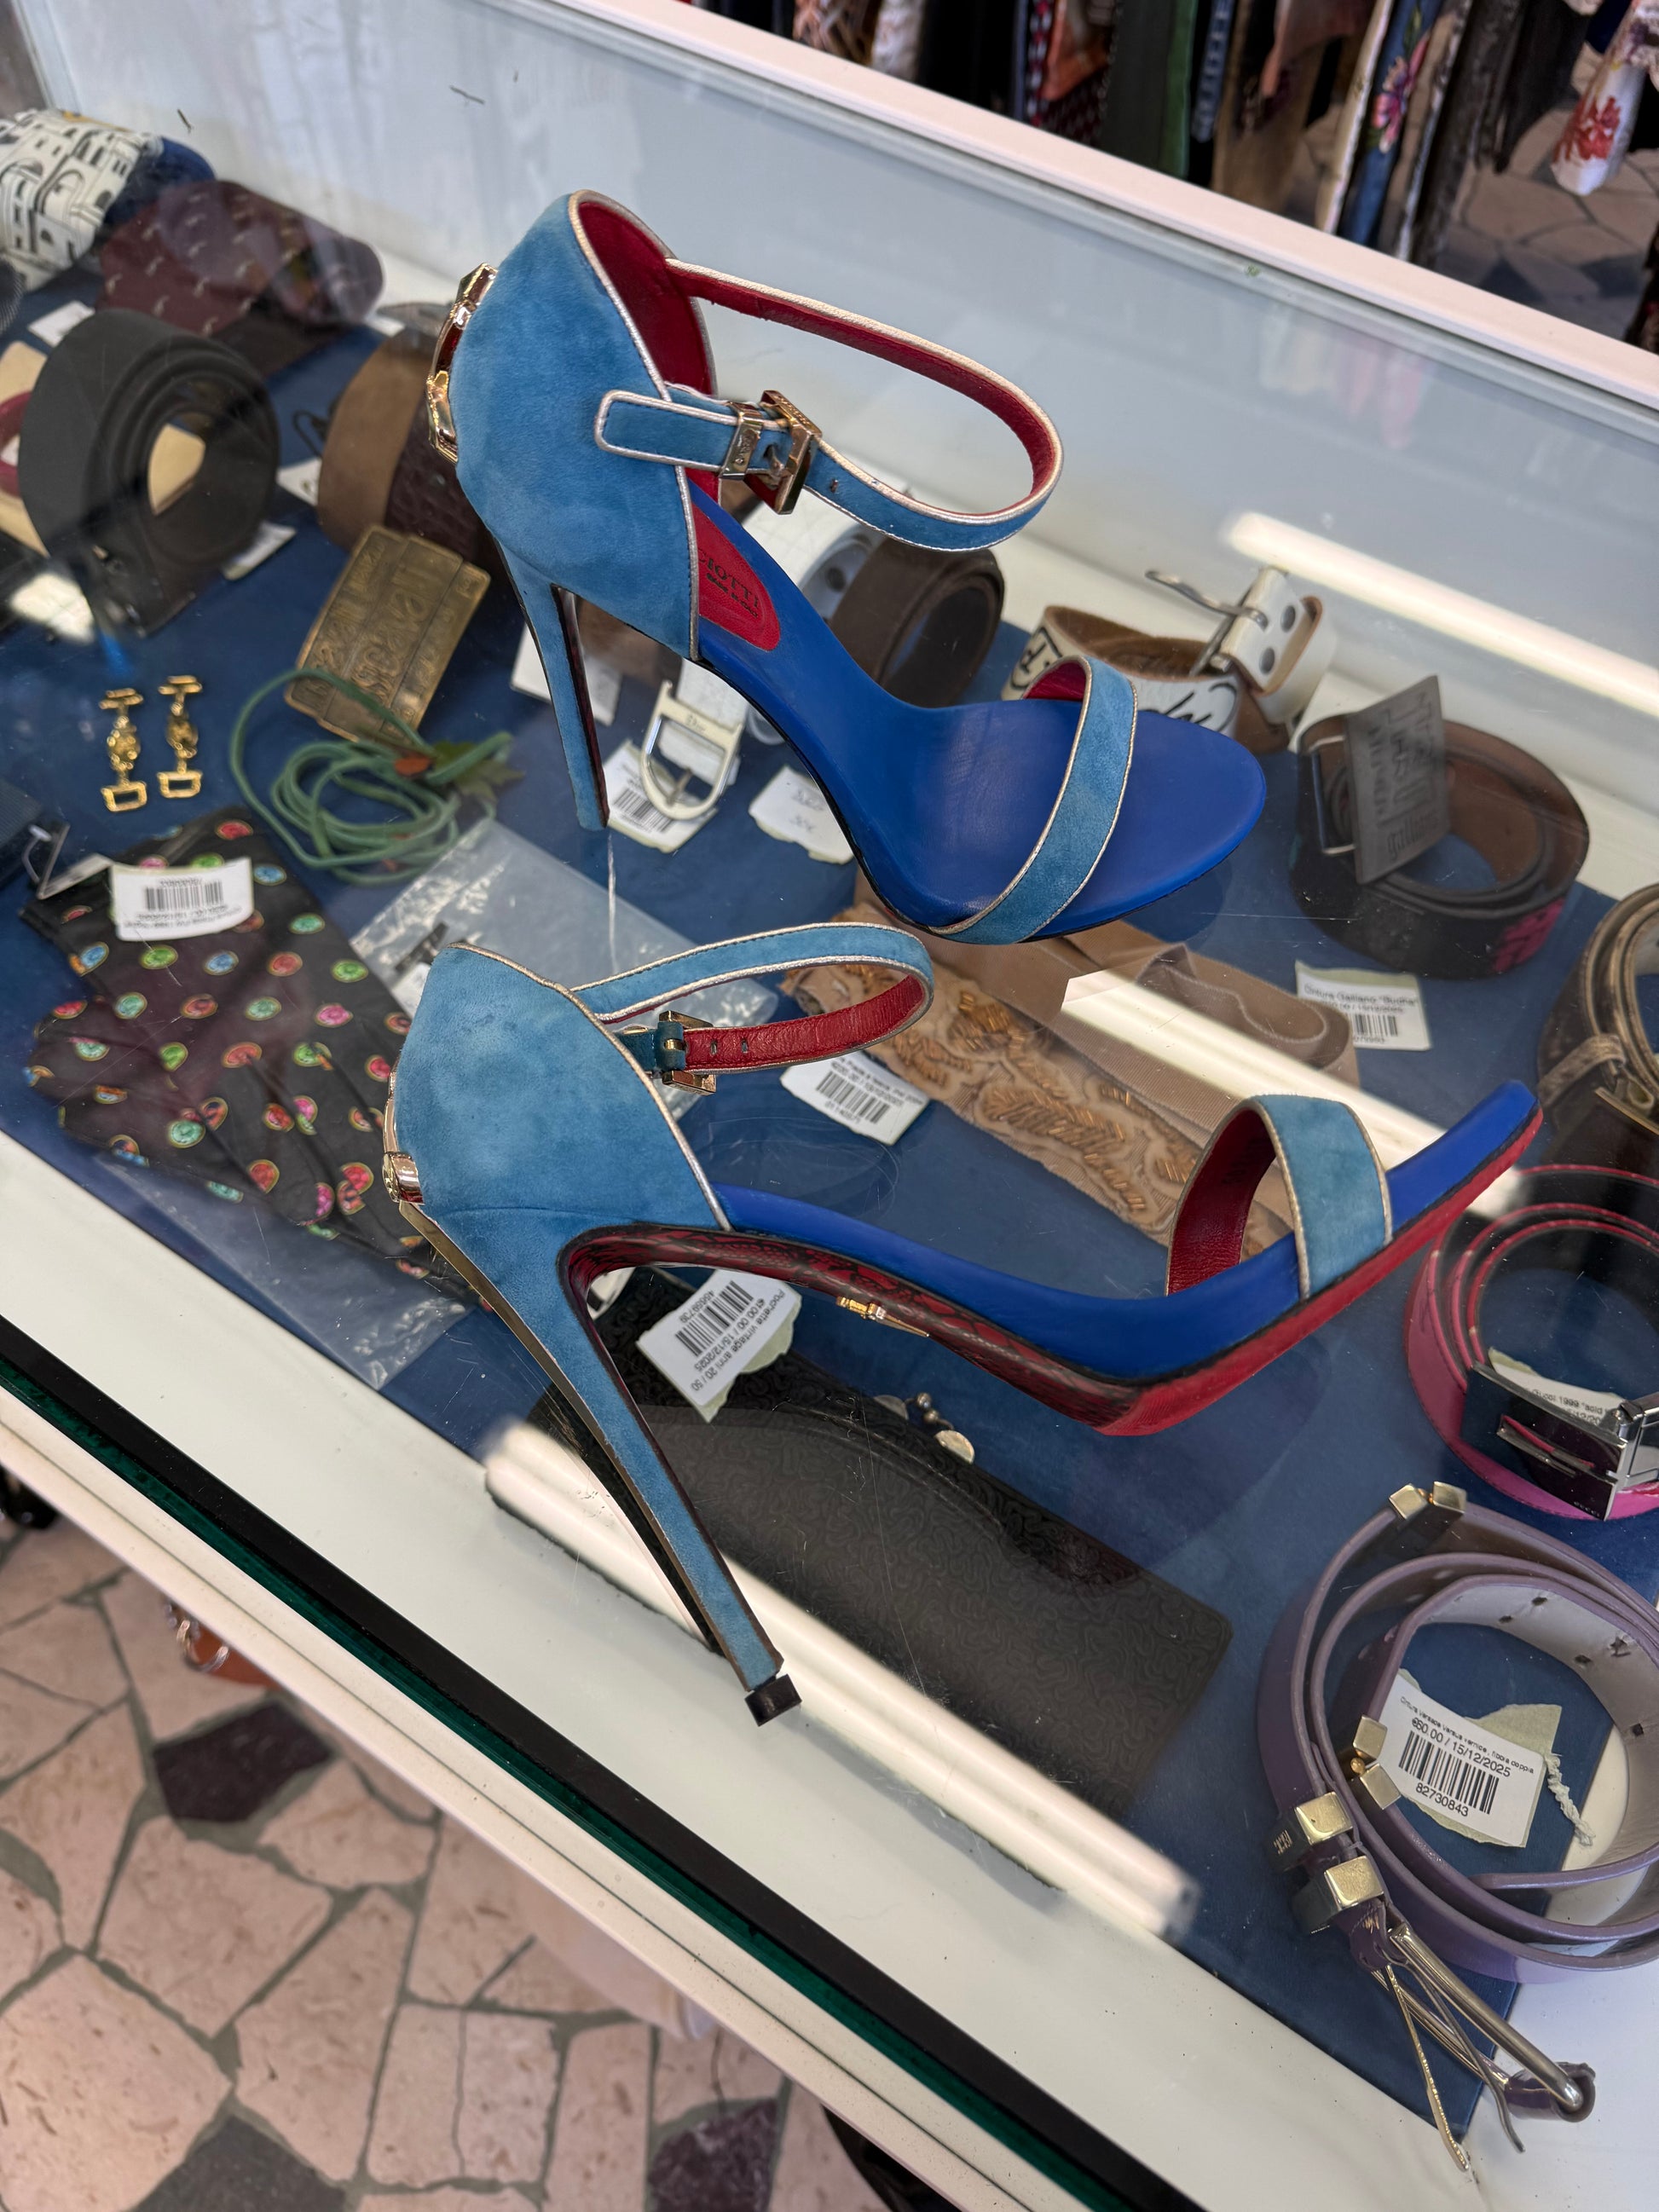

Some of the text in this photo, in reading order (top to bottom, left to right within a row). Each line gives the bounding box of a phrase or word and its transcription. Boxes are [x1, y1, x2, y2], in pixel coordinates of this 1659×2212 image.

[730, 1324, 758, 1353] vintage
[693, 1331, 735, 1372] 15/12/2025
[714, 1351, 734, 1370] anni
[690, 1377, 704, 1391] 50
[703, 1366, 718, 1379] 20
[1558, 1395, 1581, 1408] 1999
[1450, 1741, 1512, 1778] 15/12/2025
[1414, 1782, 1471, 1817] 82730843
